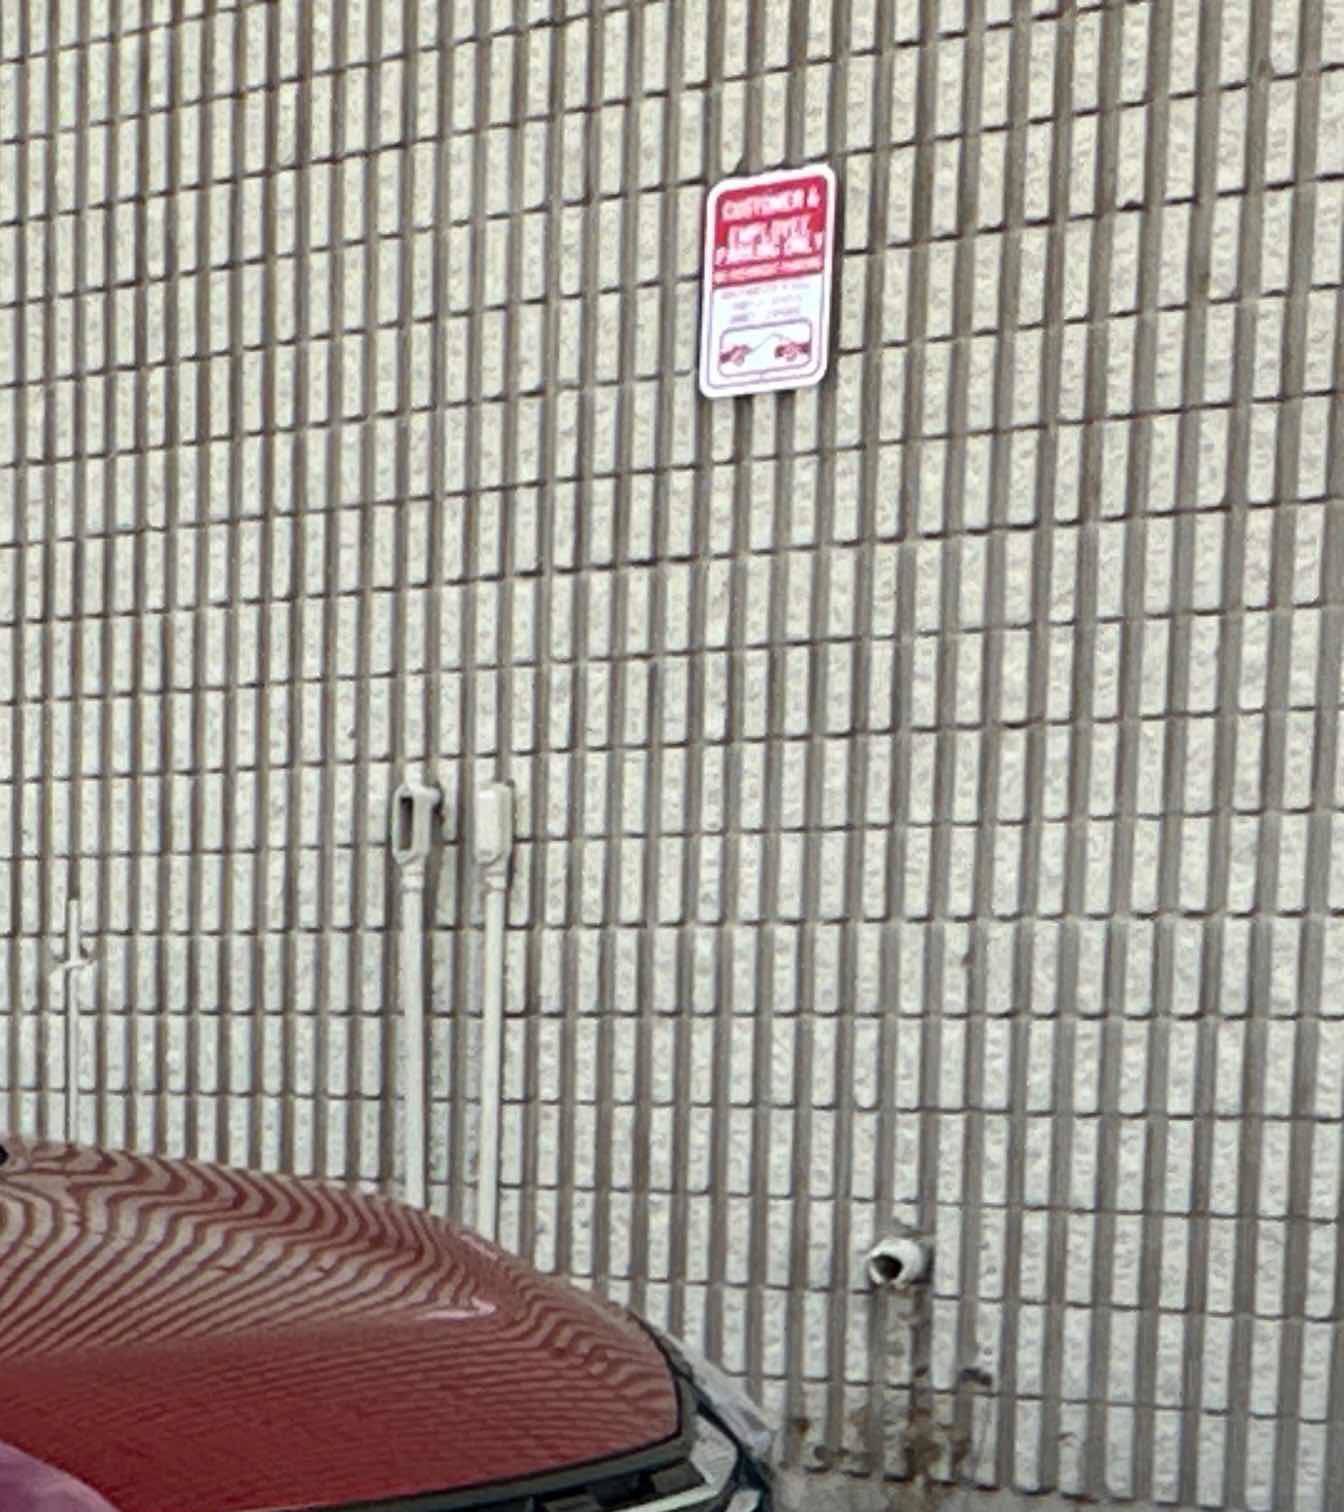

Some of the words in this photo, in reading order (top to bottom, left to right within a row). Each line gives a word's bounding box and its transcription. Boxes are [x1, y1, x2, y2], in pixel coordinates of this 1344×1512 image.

[721, 188, 805, 221] CUSTOMER
[806, 184, 820, 208] &
[714, 238, 780, 266] PARKING
[783, 231, 823, 257] ONLY
